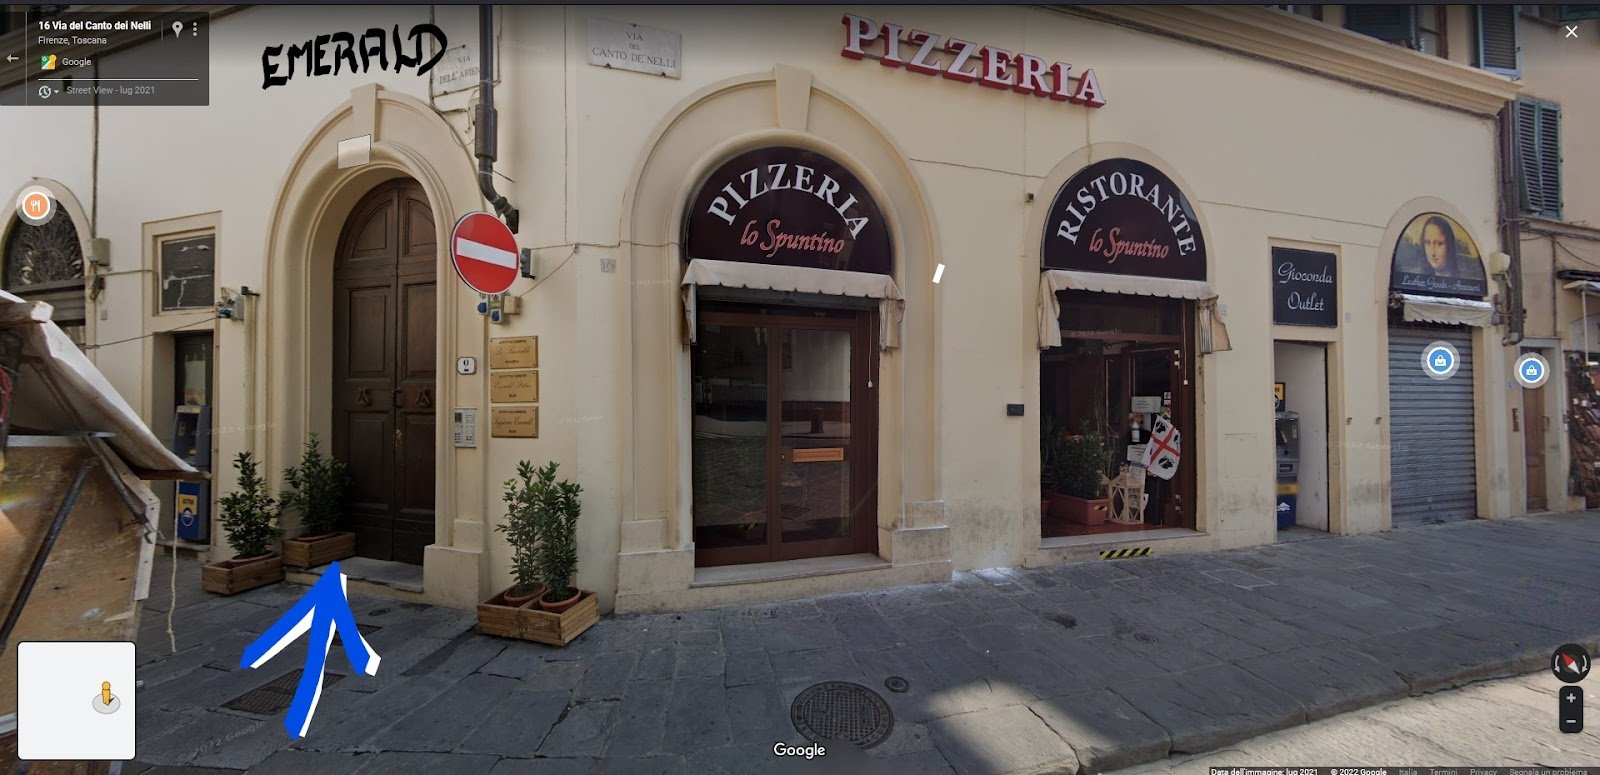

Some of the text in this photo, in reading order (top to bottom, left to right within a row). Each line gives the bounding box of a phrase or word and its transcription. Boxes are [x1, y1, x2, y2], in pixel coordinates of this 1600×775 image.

[626, 32, 643, 41] VIA
[262, 24, 448, 90] EMERALD
[592, 47, 627, 60] CANTO
[647, 56, 676, 68] NELLI
[841, 13, 1106, 108] PIZZERIA
[707, 163, 869, 240] PIZZERIA
[1057, 172, 1196, 256] RISTORANTE
[740, 219, 845, 258] lo Spuntino
[1089, 227, 1169, 264] lo Spuntino
[1278, 262, 1333, 284] Gioconda
[1287, 291, 1325, 311] Outlet
